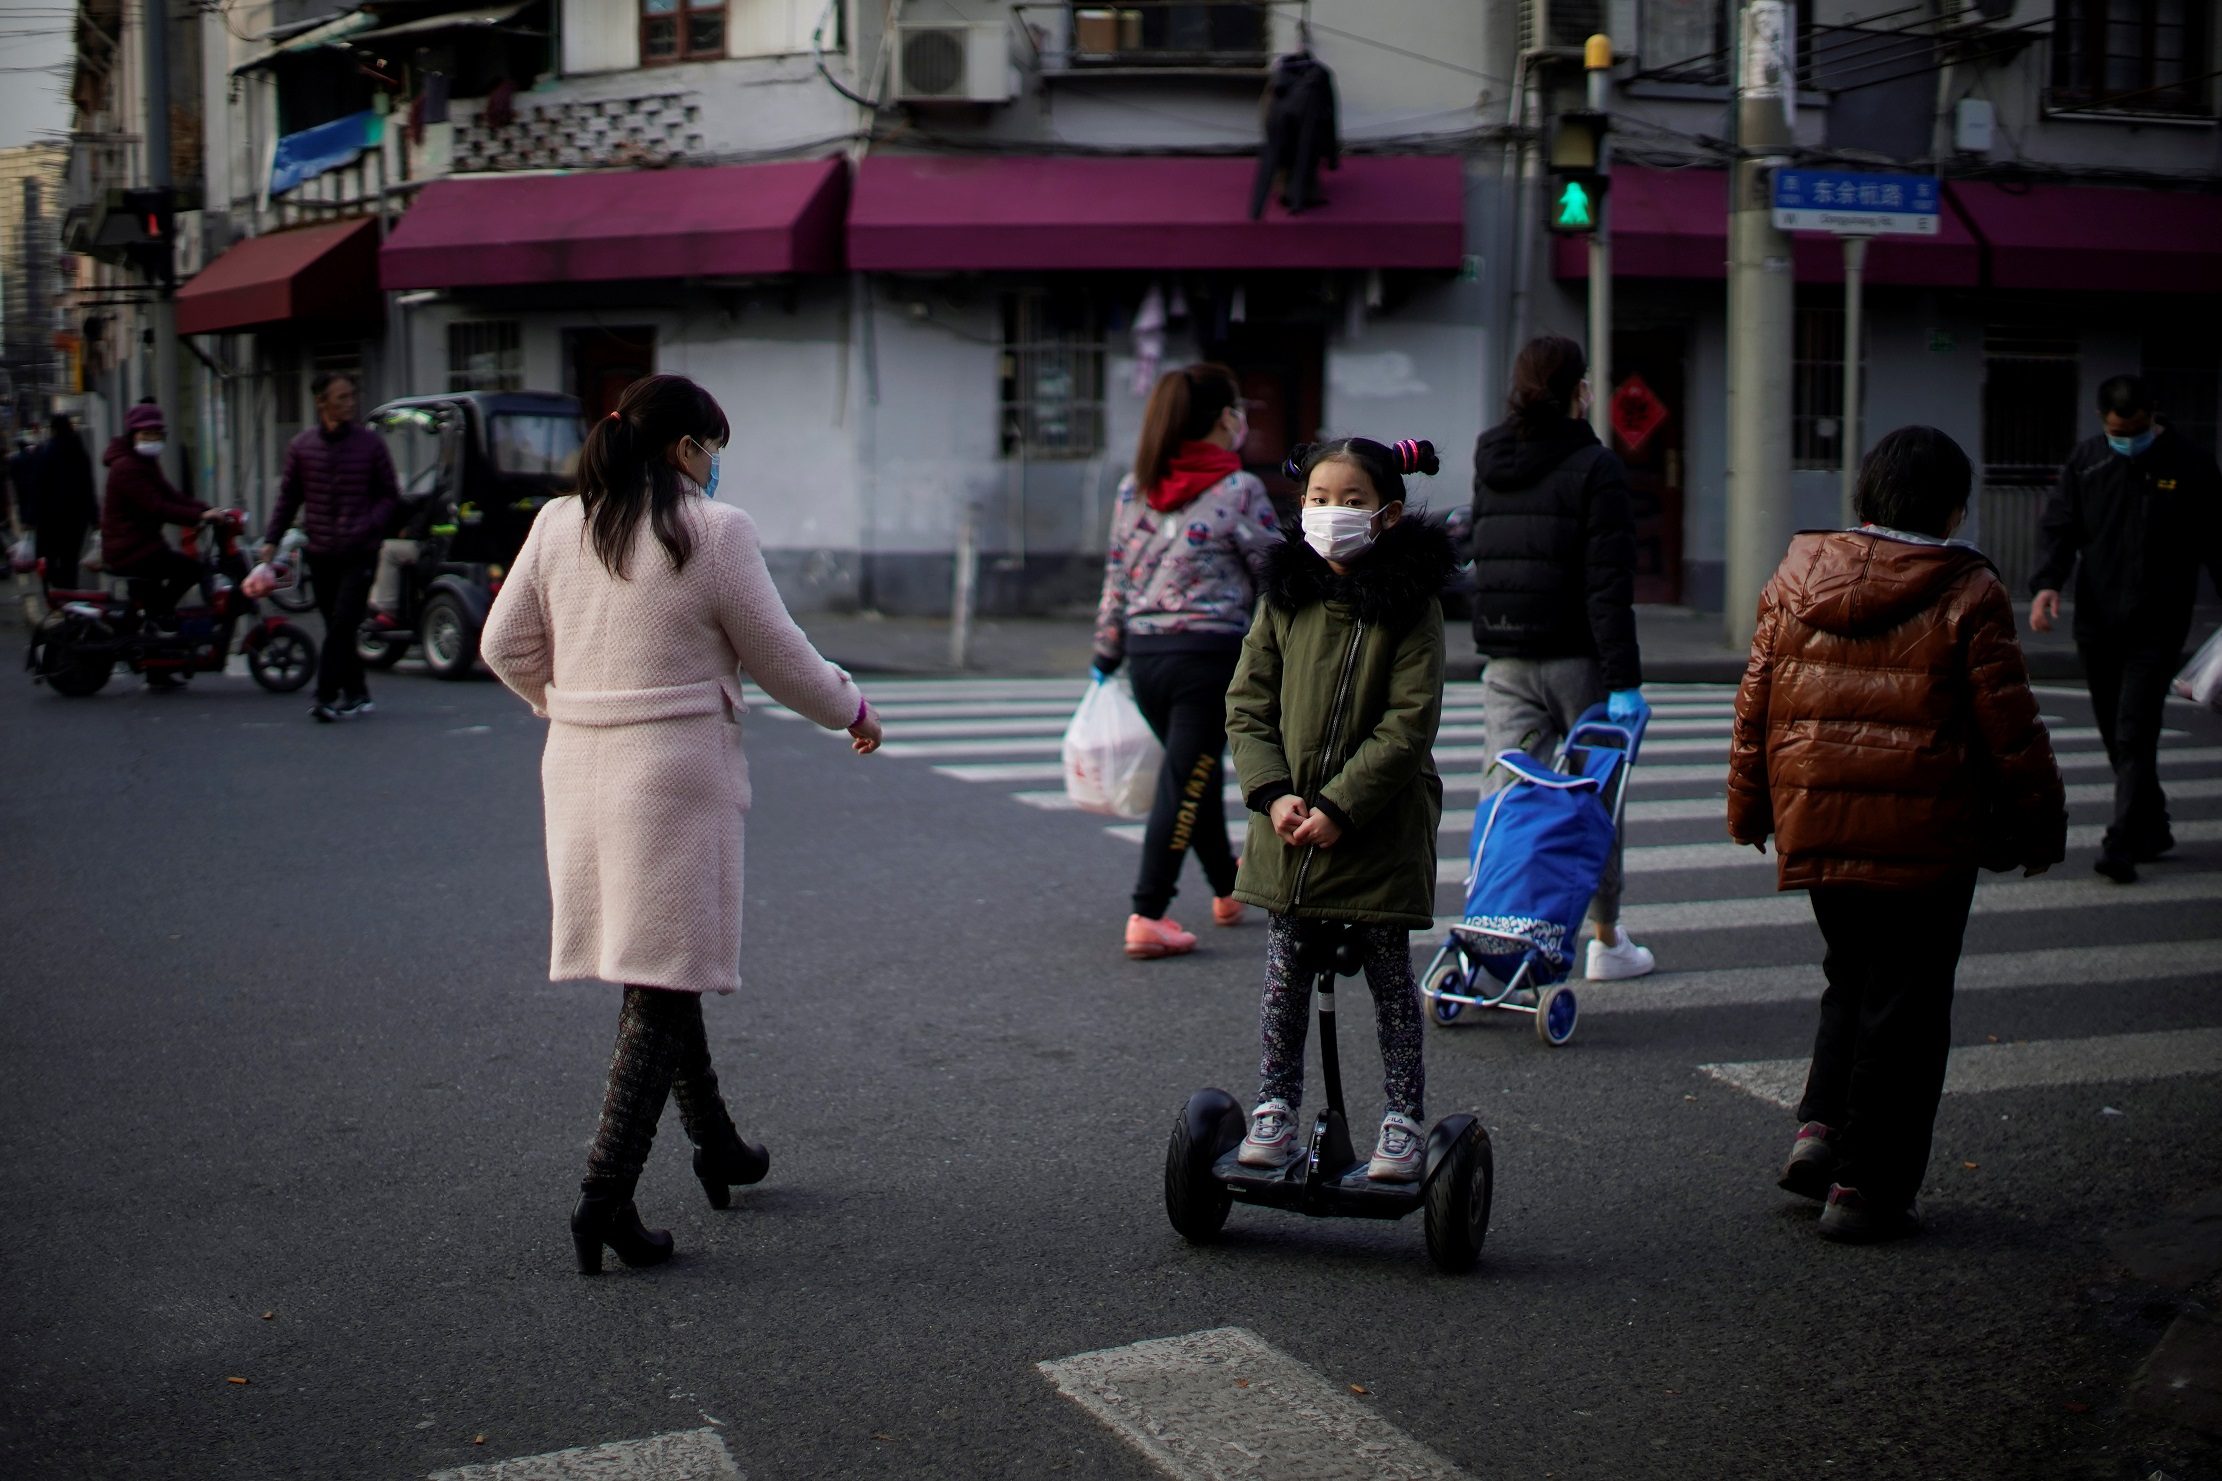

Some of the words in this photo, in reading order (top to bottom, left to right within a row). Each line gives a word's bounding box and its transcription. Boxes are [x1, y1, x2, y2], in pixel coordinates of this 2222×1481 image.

[1185, 753, 1217, 799] NEW
[1168, 800, 1200, 851] YORK
[1269, 1103, 1287, 1112] FILA
[1386, 1116, 1404, 1124] FILA
